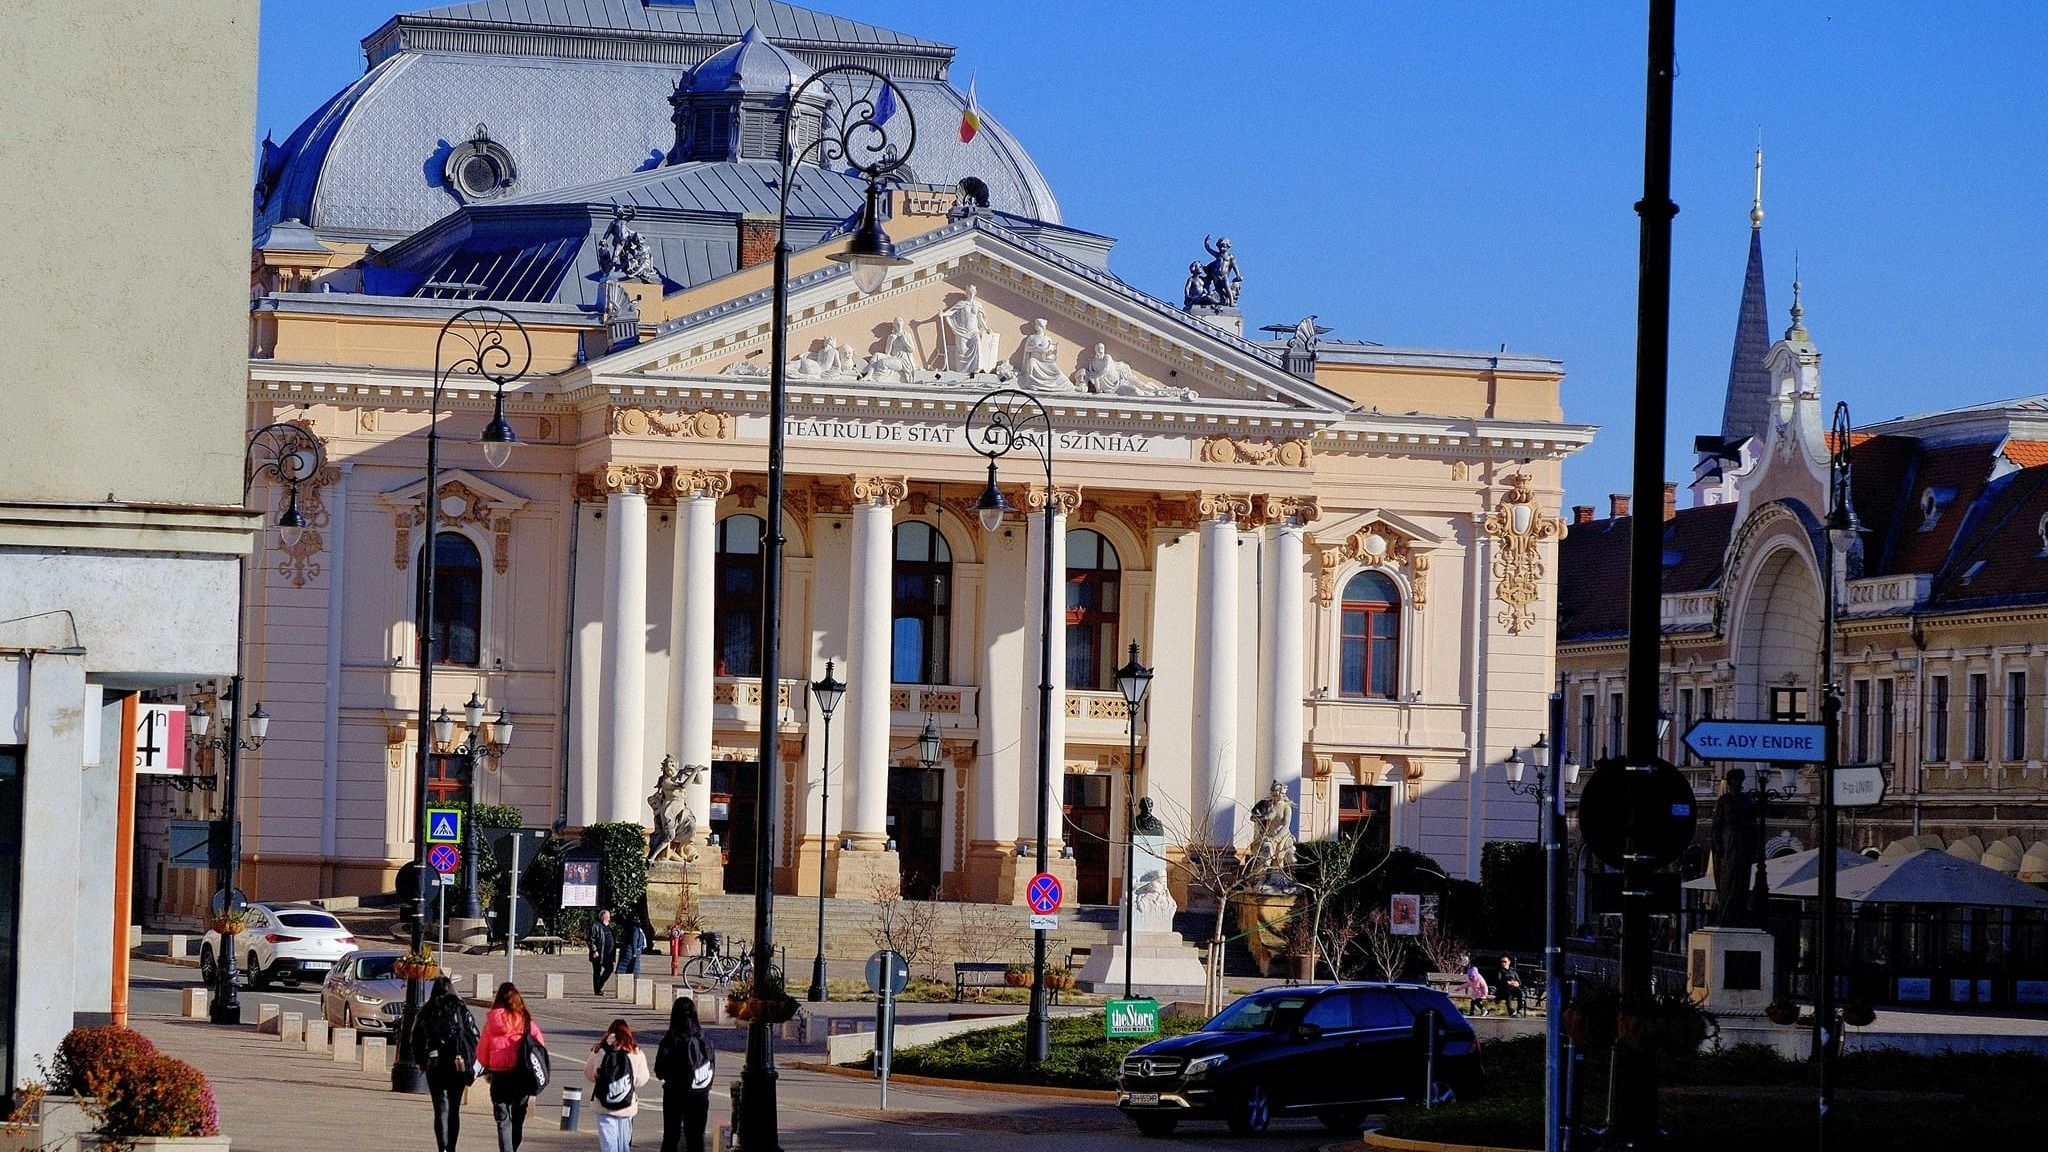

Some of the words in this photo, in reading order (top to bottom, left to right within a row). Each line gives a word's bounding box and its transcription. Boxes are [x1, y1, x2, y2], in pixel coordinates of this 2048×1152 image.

[784, 421, 872, 439] TEATRUL
[876, 425, 902, 441] DE
[908, 427, 955, 443] STAT
[1699, 735, 1722, 747] str.
[1727, 734, 1758, 748] ADY
[1762, 736, 1814, 750] ENDRE
